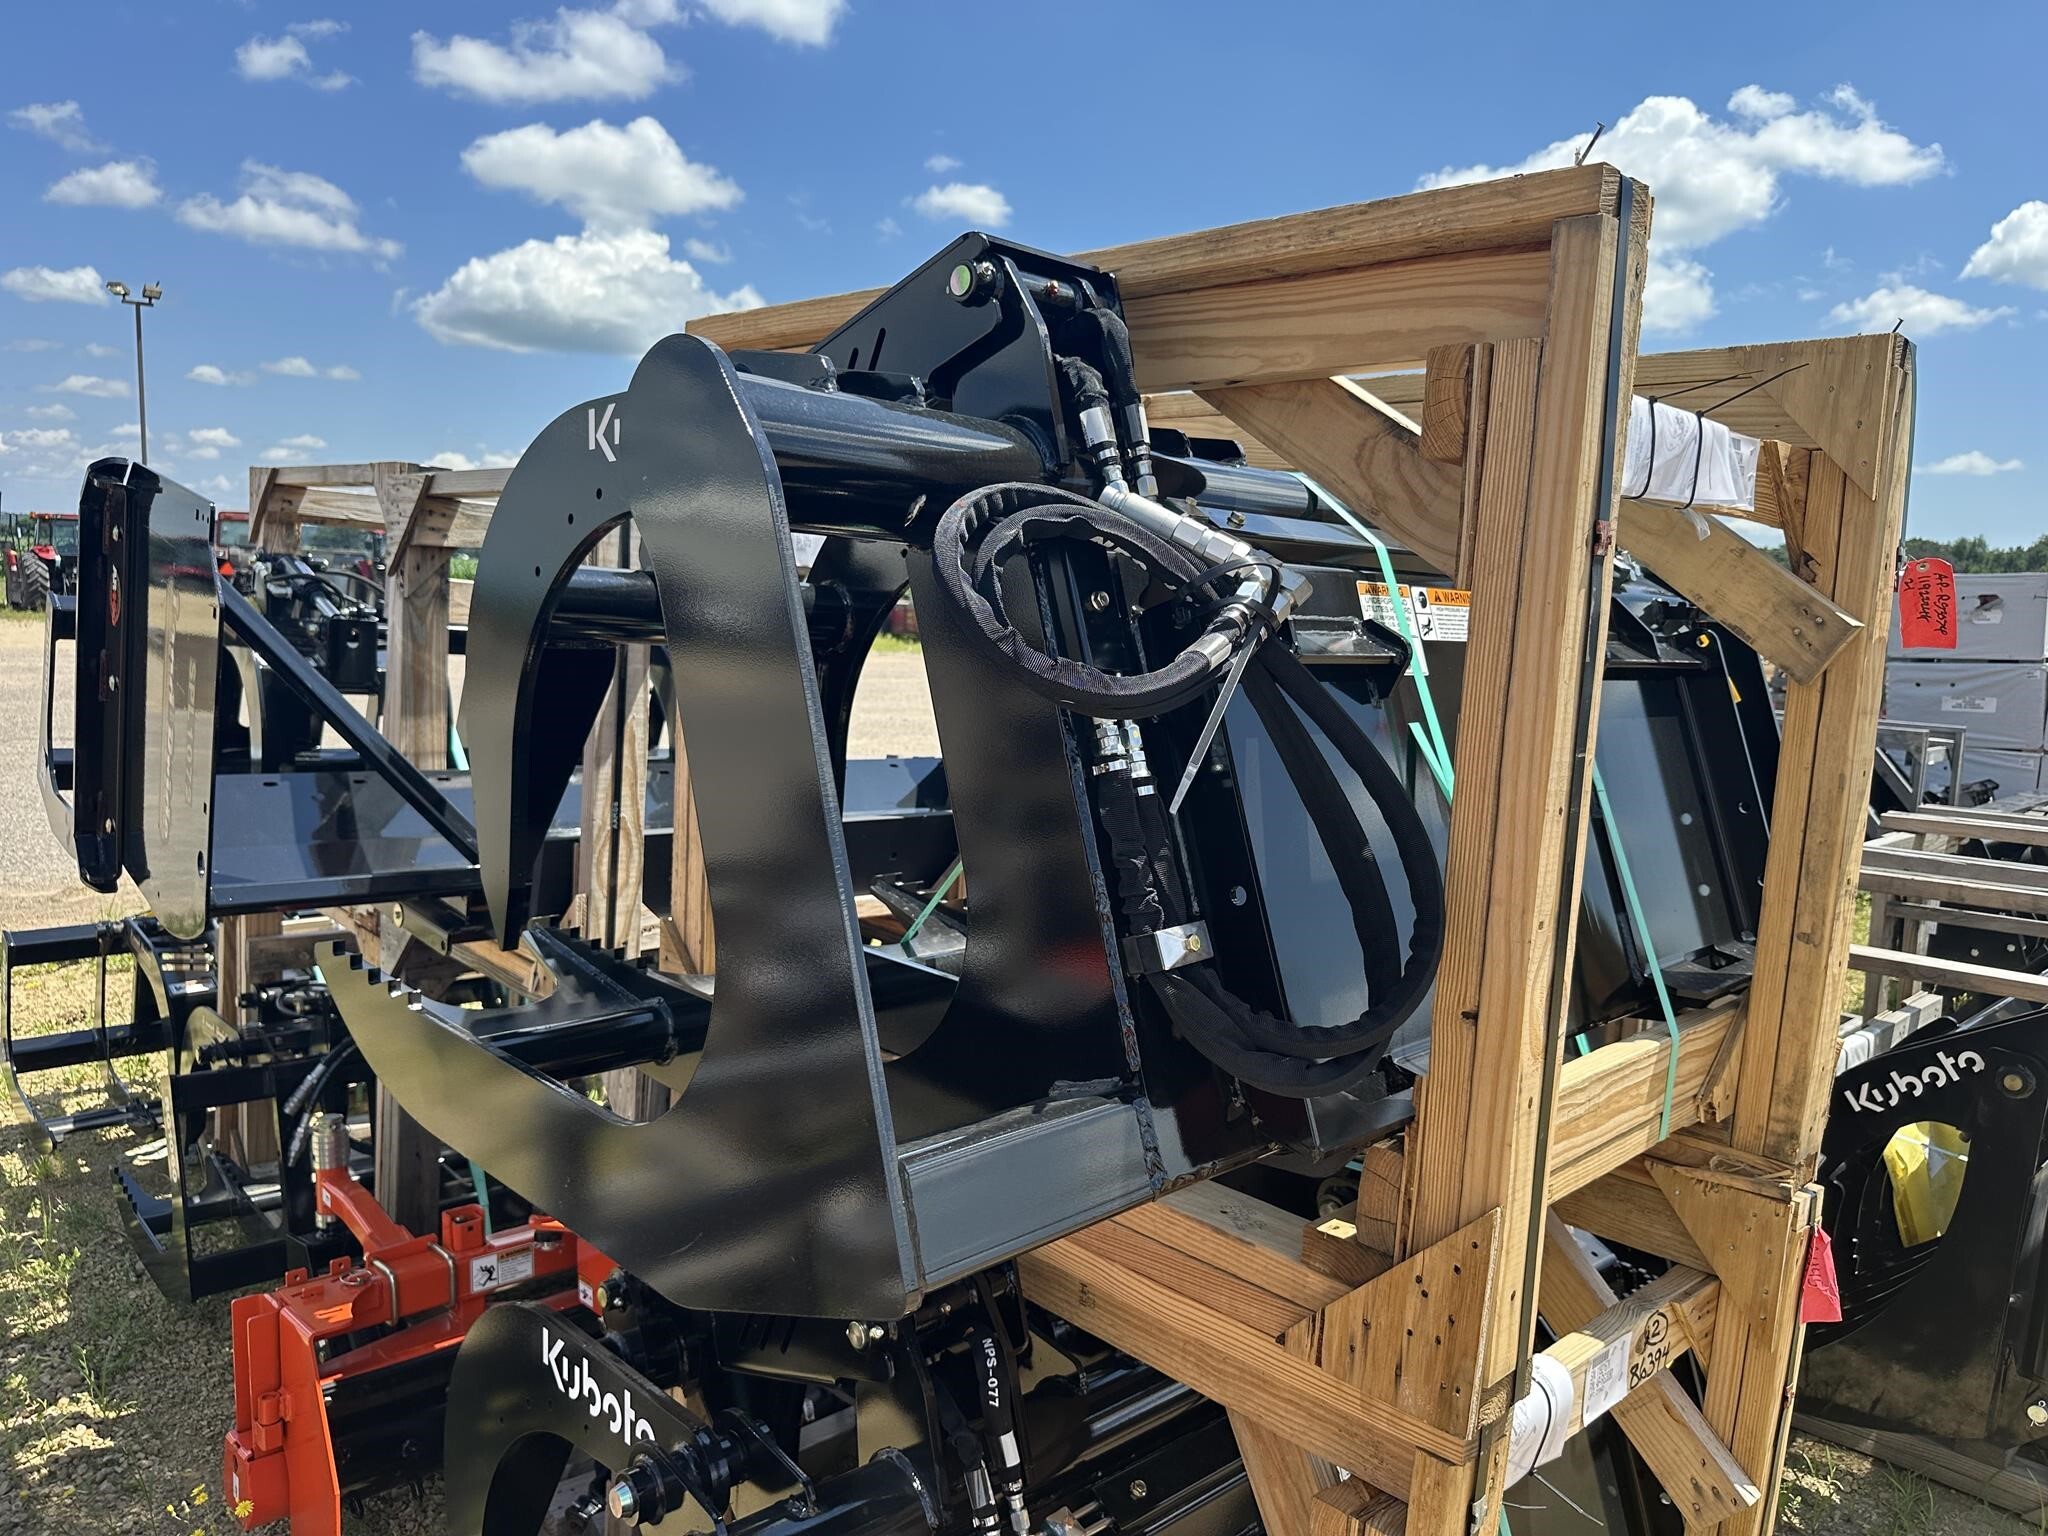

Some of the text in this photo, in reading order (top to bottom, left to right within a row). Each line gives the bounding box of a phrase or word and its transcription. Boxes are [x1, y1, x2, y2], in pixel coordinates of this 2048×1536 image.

[1443, 590, 1471, 604] WARNIN
[1844, 1051, 1985, 1113] Kubota
[542, 1326, 656, 1446] Kubota
[982, 1337, 999, 1408] NPS-077
[1630, 1341, 1671, 1390] 86394
